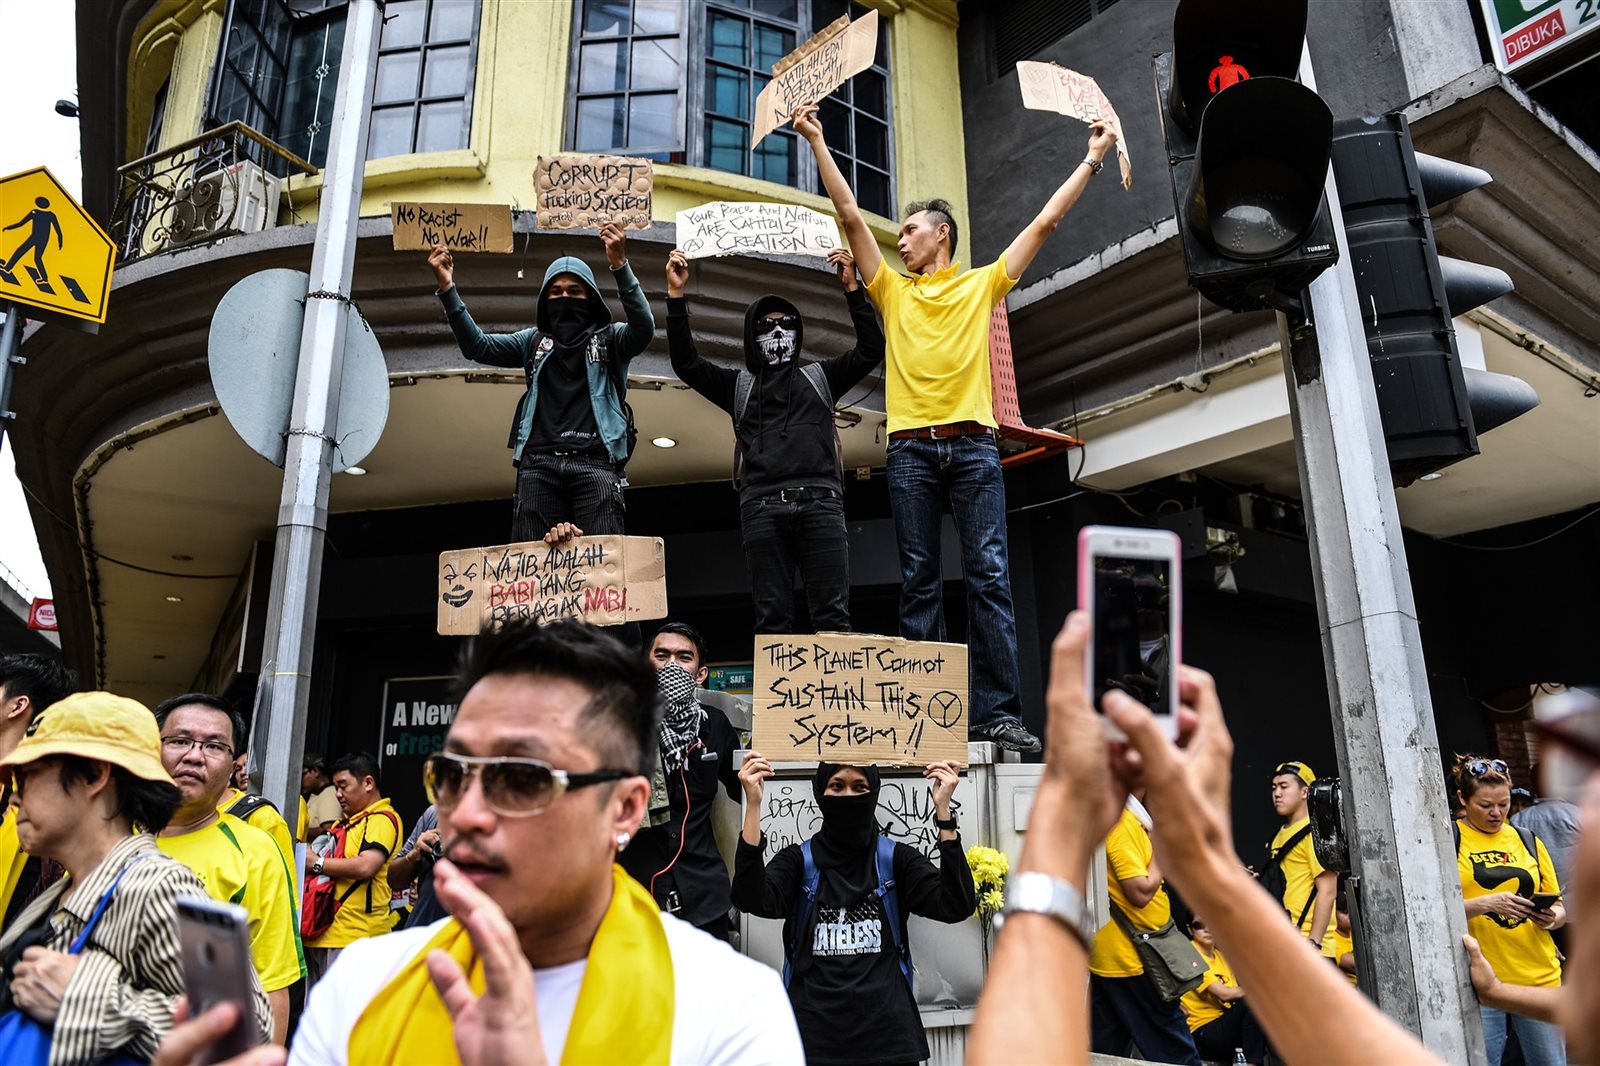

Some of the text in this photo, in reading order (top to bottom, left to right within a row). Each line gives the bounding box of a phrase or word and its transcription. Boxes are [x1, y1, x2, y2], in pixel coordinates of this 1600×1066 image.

[1506, 0, 1600, 58] DIBUKA 2
[697, 220, 725, 237] ARE
[715, 229, 807, 251] CREATION
[482, 544, 608, 584] NAJIB ADALAH
[486, 571, 586, 610] BABI YANG
[813, 644, 876, 674] PLANET
[392, 701, 458, 726] A New
